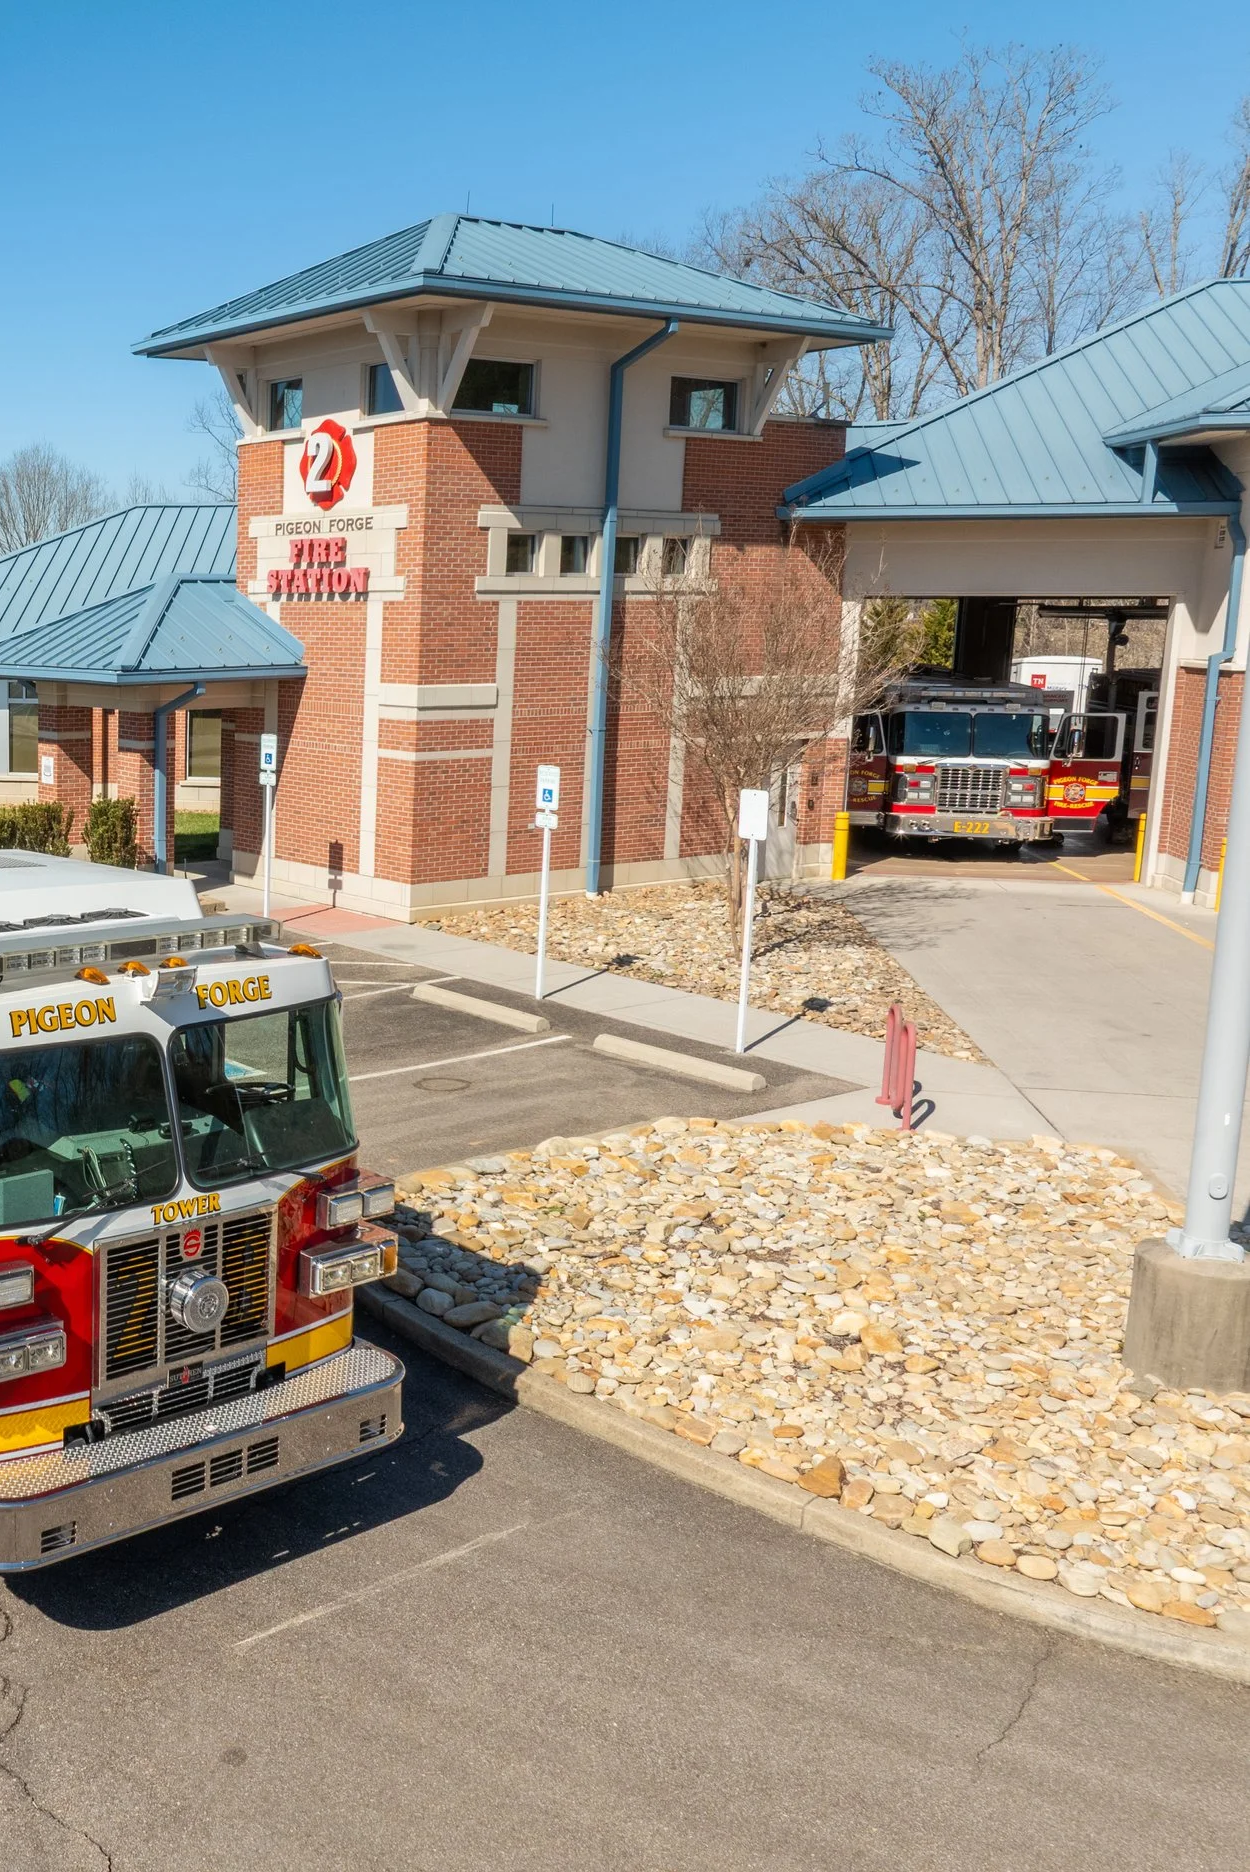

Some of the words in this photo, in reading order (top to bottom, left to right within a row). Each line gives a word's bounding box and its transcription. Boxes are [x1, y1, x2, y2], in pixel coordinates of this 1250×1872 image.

[306, 432, 333, 493] 2
[275, 520, 321, 536] PIGEON
[329, 516, 373, 533] FORGE
[289, 537, 347, 563] FIRE
[267, 567, 369, 594] STATION
[954, 821, 990, 834] E-222
[9, 997, 117, 1037] PIGEON
[195, 974, 273, 1009] FORGE
[151, 1193, 221, 1225] TOWER
